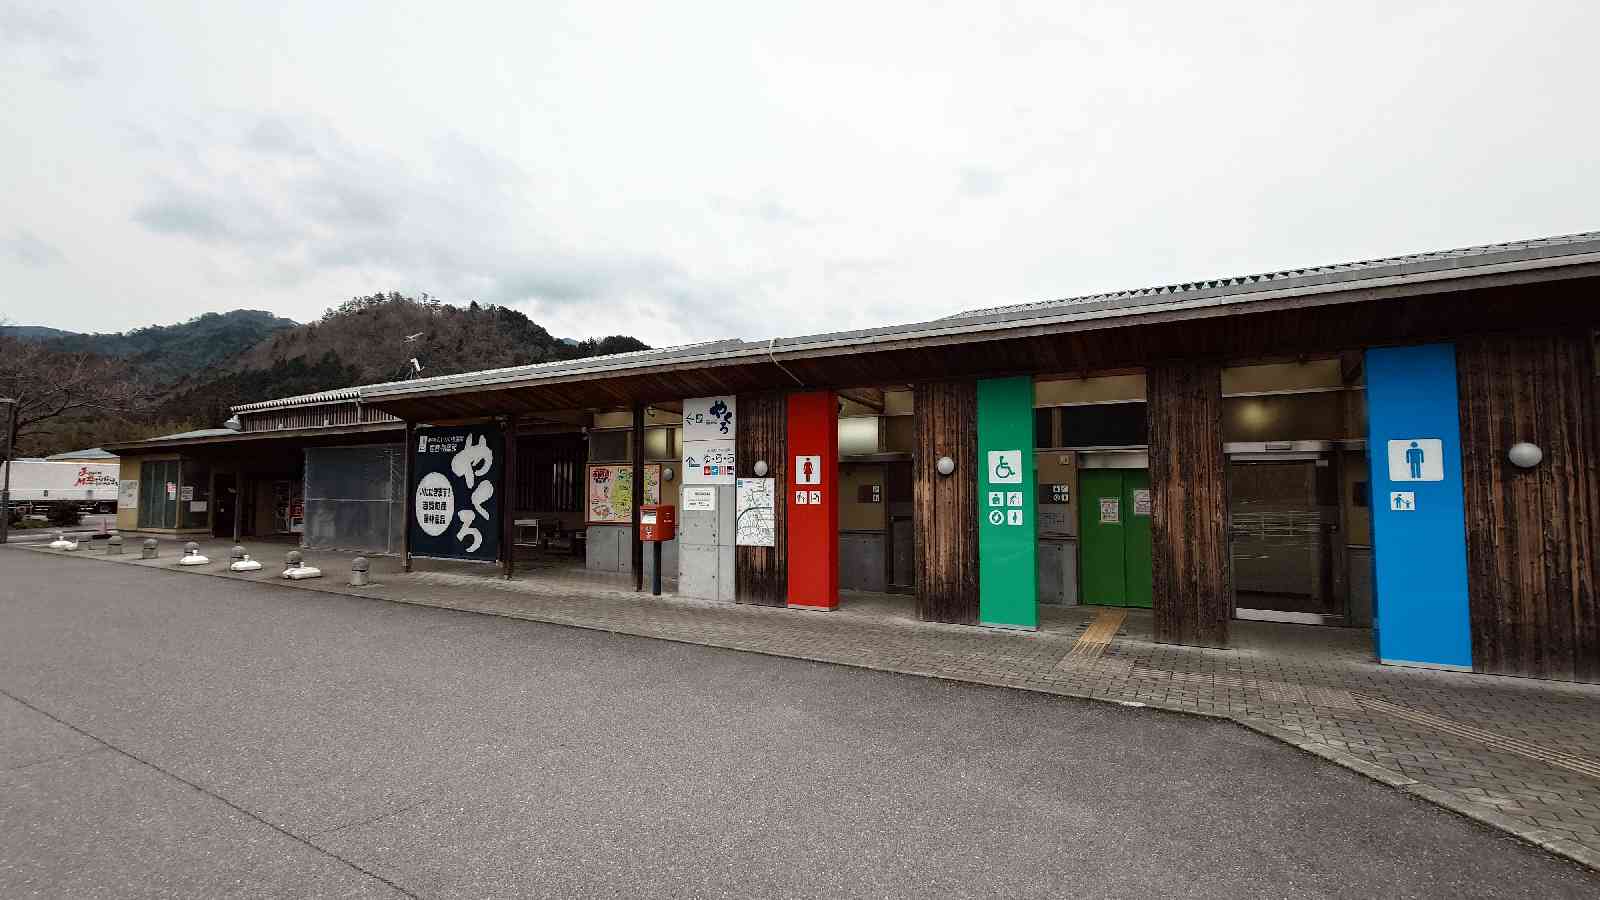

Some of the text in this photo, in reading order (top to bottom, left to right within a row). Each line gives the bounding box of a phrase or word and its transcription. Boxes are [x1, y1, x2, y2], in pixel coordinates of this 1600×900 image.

[710, 400, 733, 434] やくろ
[451, 433, 494, 552] やくろ
